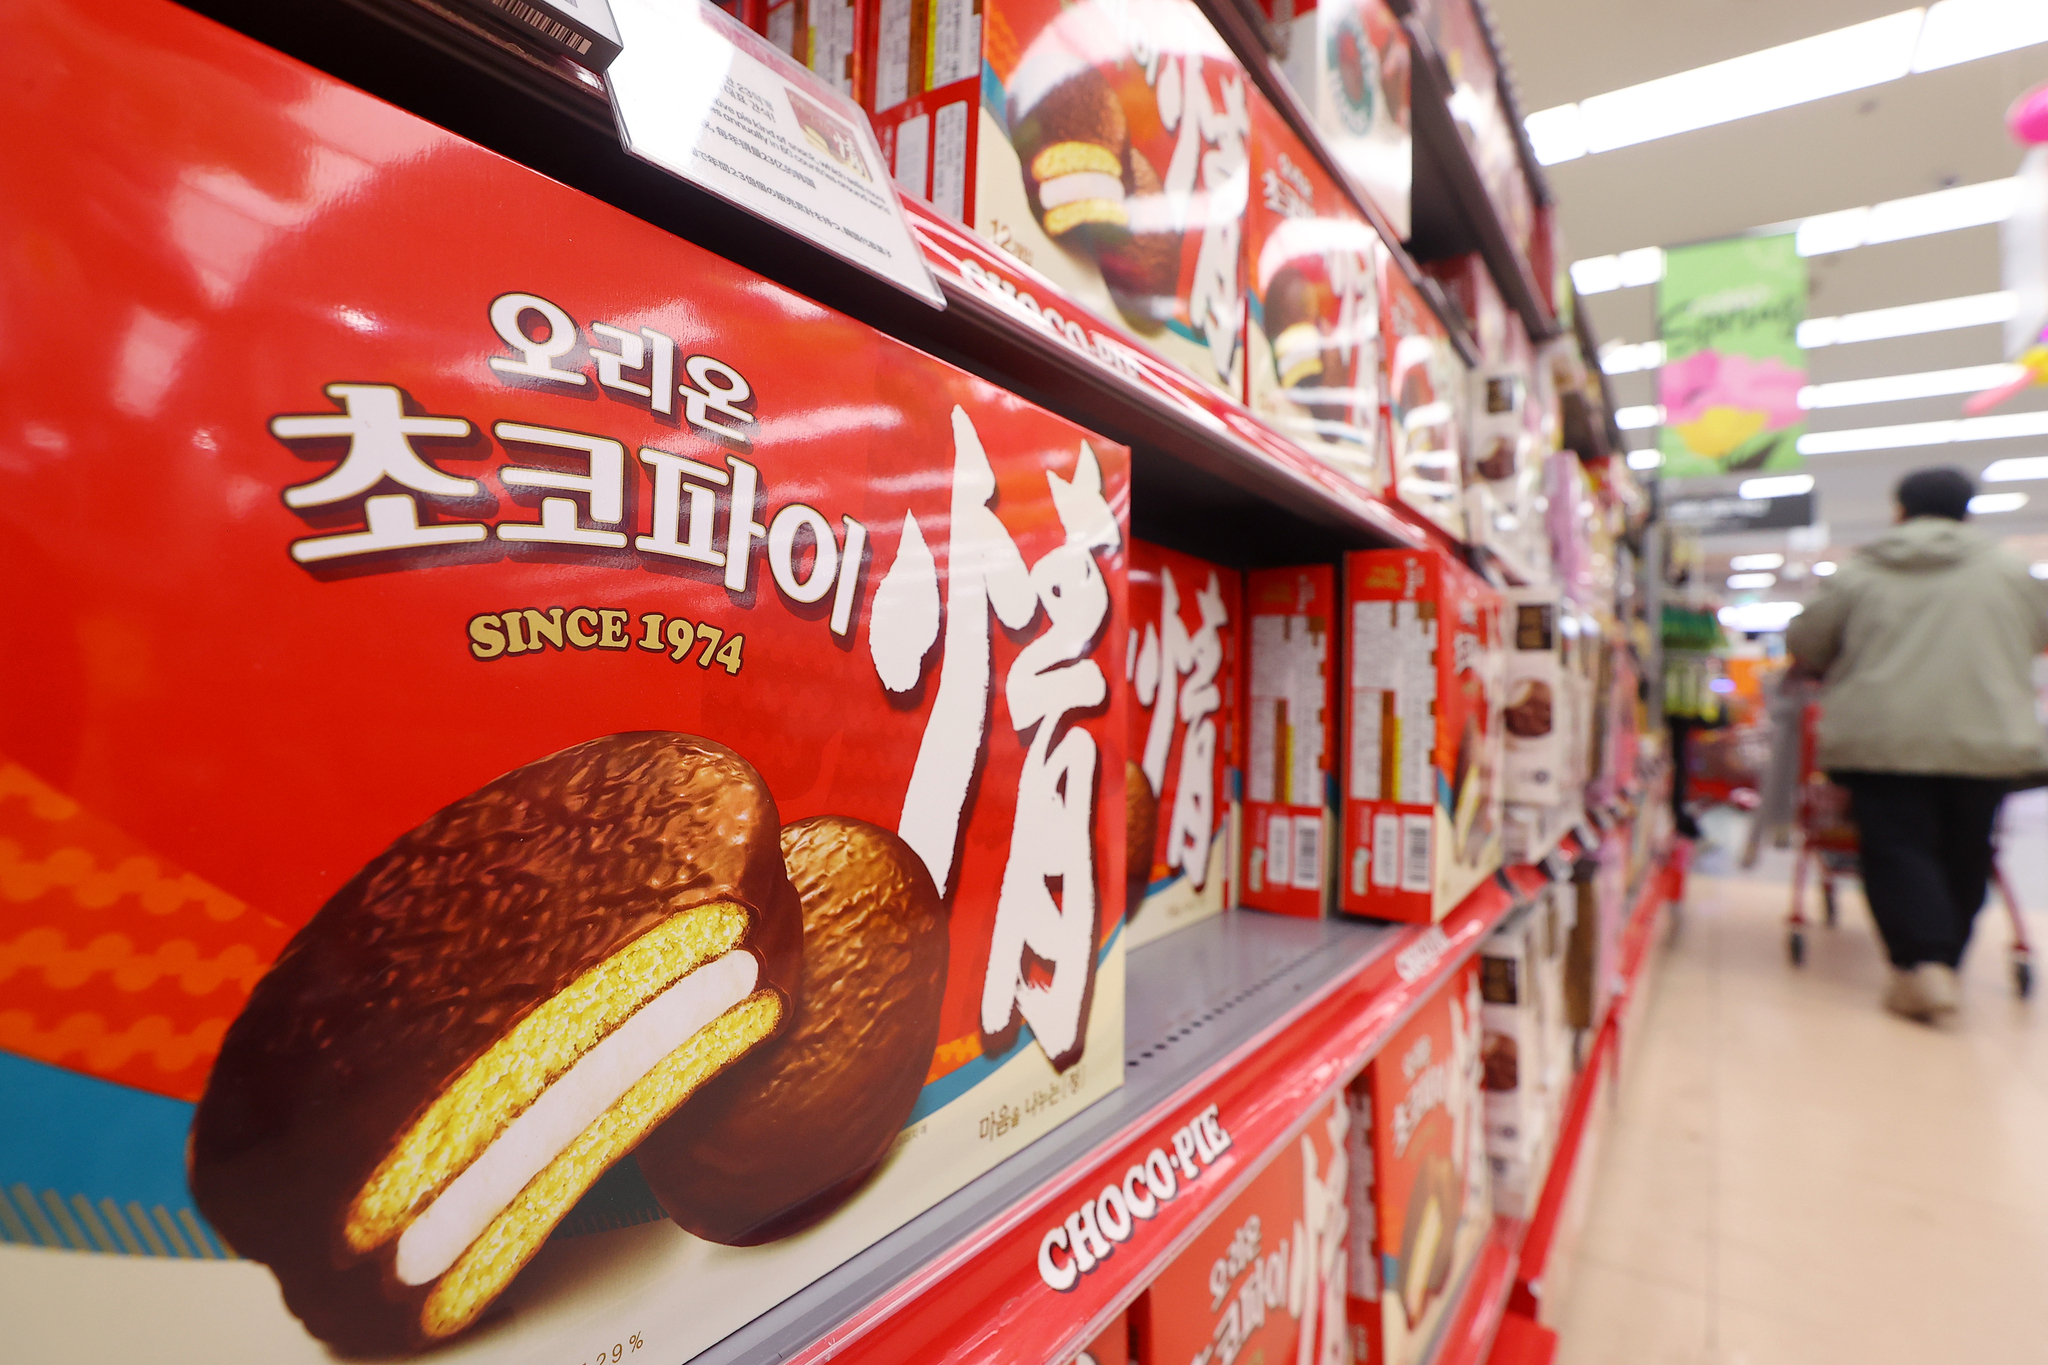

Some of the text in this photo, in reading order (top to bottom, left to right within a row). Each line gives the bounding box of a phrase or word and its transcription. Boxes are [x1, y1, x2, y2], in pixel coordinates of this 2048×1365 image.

[722, 112, 767, 144] annually
[752, 118, 775, 138] kind
[488, 291, 759, 446] 오리온
[268, 381, 868, 637] 초코파이
[467, 608, 745, 673] SINCE 1974
[868, 404, 1121, 1066] 情
[979, 1104, 1020, 1141] 마음을
[581, 1331, 644, 1365] 29%
